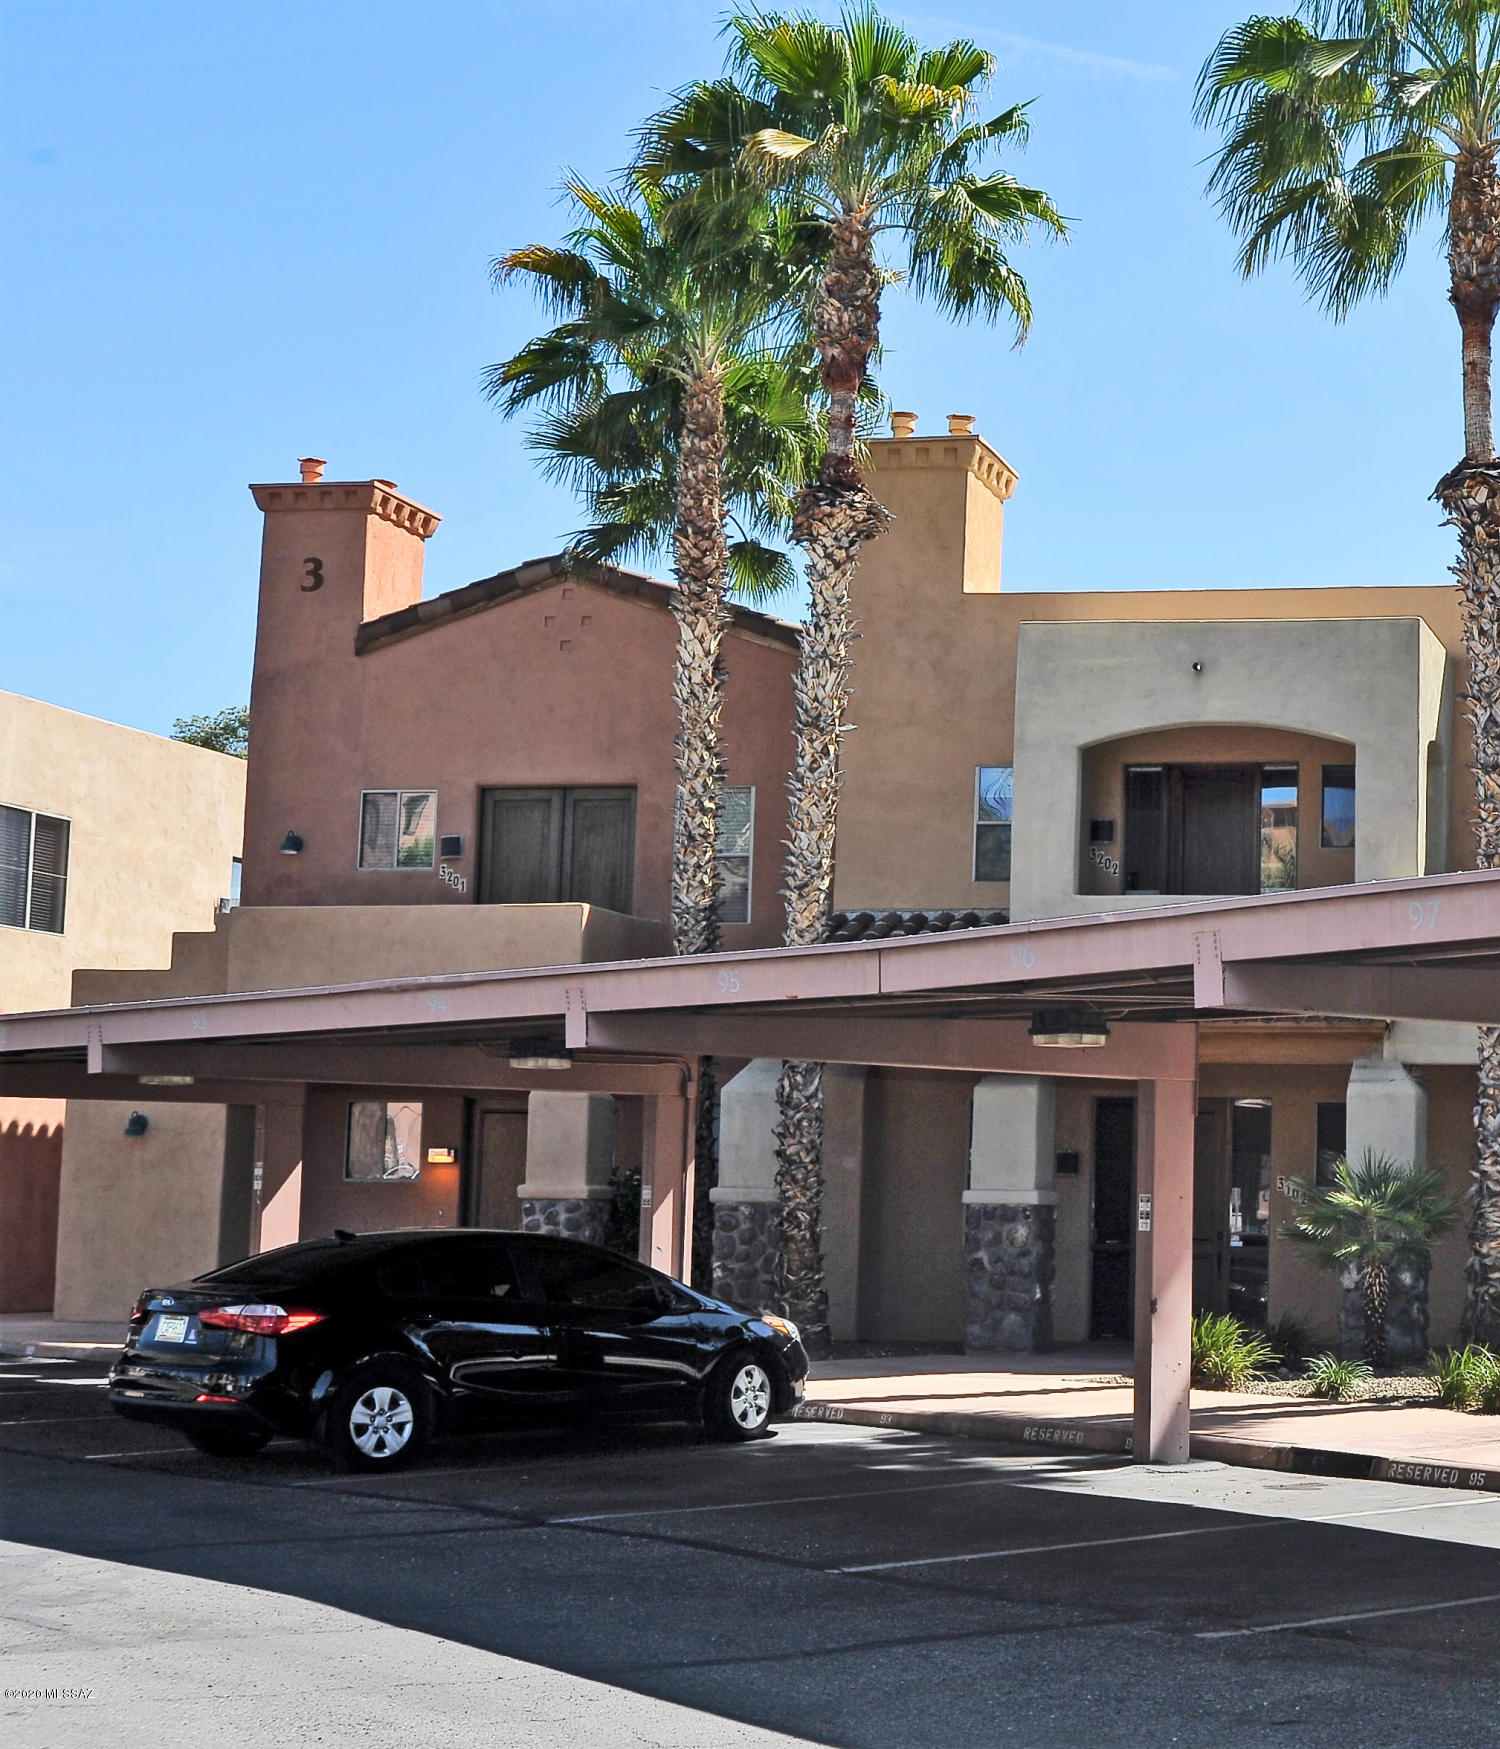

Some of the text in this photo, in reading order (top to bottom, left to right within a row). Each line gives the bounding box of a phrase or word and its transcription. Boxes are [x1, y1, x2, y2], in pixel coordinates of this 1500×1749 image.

[300, 556, 325, 593] 3
[1090, 847, 1119, 875] 3202
[440, 865, 466, 892] 3201
[1407, 901, 1441, 931] 97
[718, 970, 741, 993] 95
[1023, 1427, 1084, 1445] RESERVED
[1387, 1463, 1486, 1486] RESERVED 95
